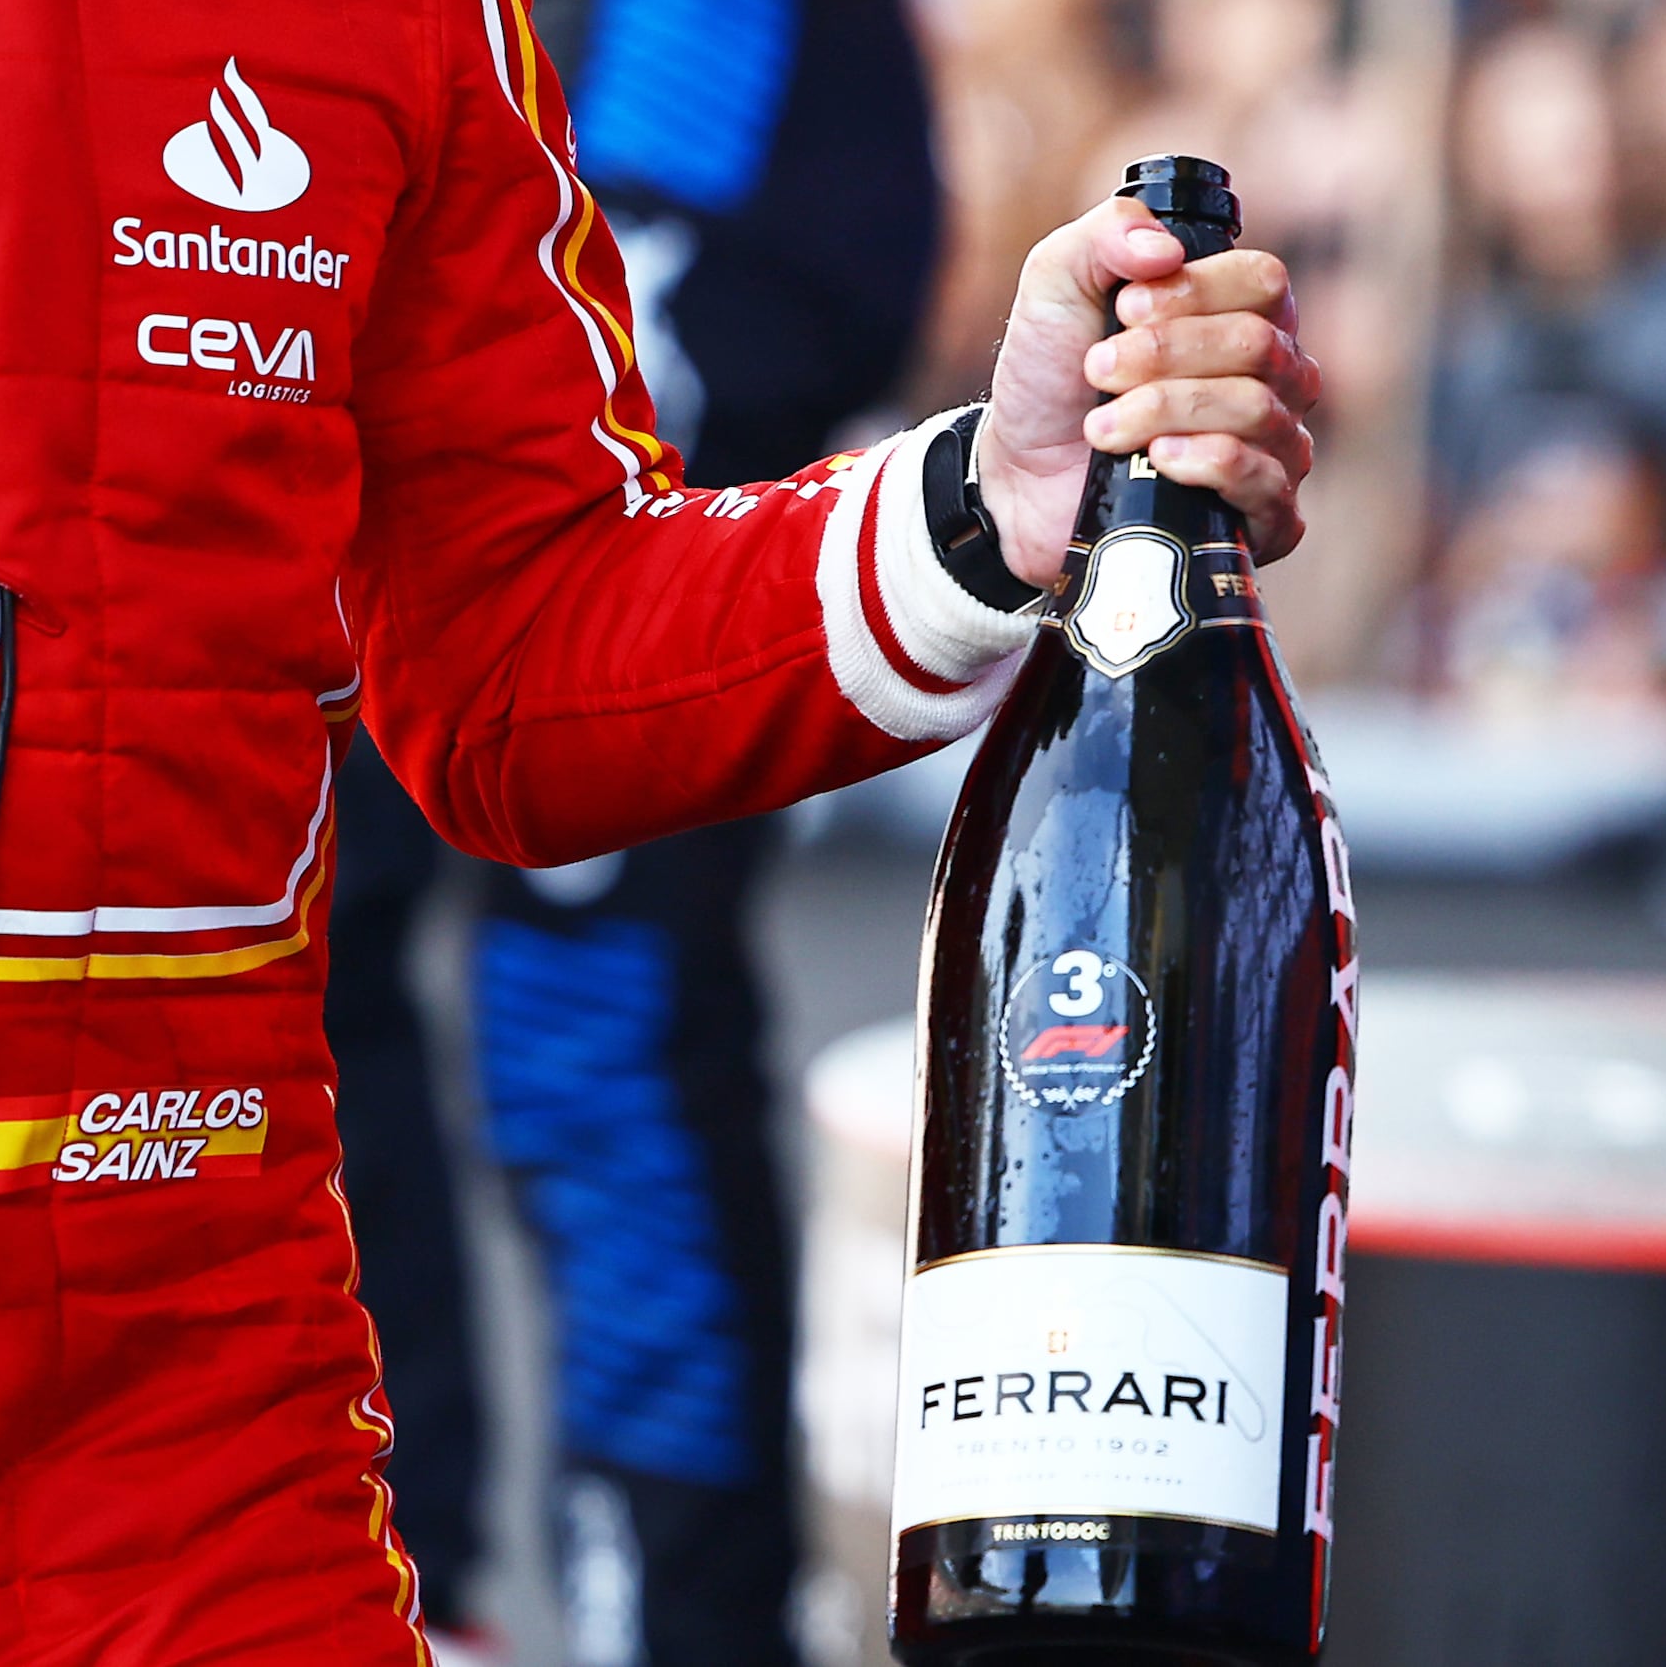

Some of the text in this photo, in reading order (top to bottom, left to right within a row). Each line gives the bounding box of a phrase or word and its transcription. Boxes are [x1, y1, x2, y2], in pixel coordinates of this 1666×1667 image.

[112, 216, 350, 290] Santander
[227, 380, 312, 404] LOGISTICS
[79, 1087, 264, 1134] CARLOS
[51, 1138, 207, 1182] SAINZ
[921, 1370, 1230, 1430] FERRARI
[991, 1521, 1111, 1543] TRENTODOC
